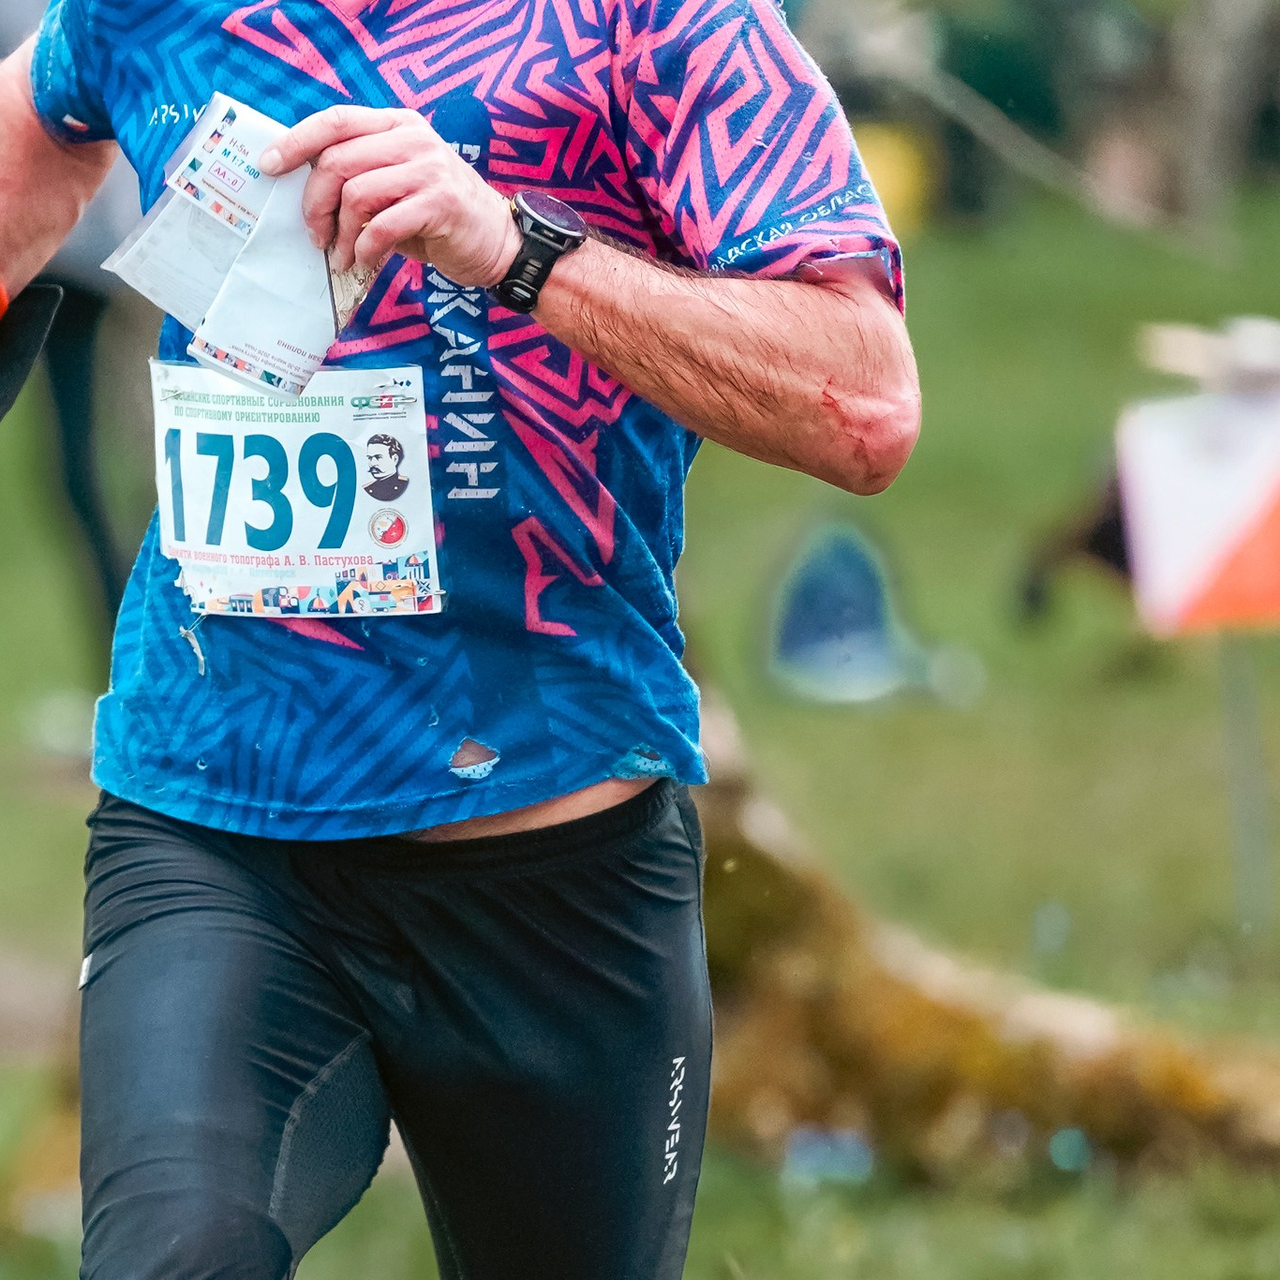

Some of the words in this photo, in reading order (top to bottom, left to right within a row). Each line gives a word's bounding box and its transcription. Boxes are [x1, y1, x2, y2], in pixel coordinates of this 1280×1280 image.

[244, 165, 260, 179] 500
[211, 394, 265, 407] СПОРТИВНЫЕ
[174, 406, 184, 416] ПО
[185, 407, 232, 421] СПОРТИВНОМУ
[235, 411, 320, 423] ОРИЕНТИРОВАНИЮ
[165, 427, 358, 552] 1739
[230, 553, 281, 569] топографа
[284, 555, 295, 566] А.
[299, 555, 310, 566] В.
[314, 555, 374, 569] Пастухова
